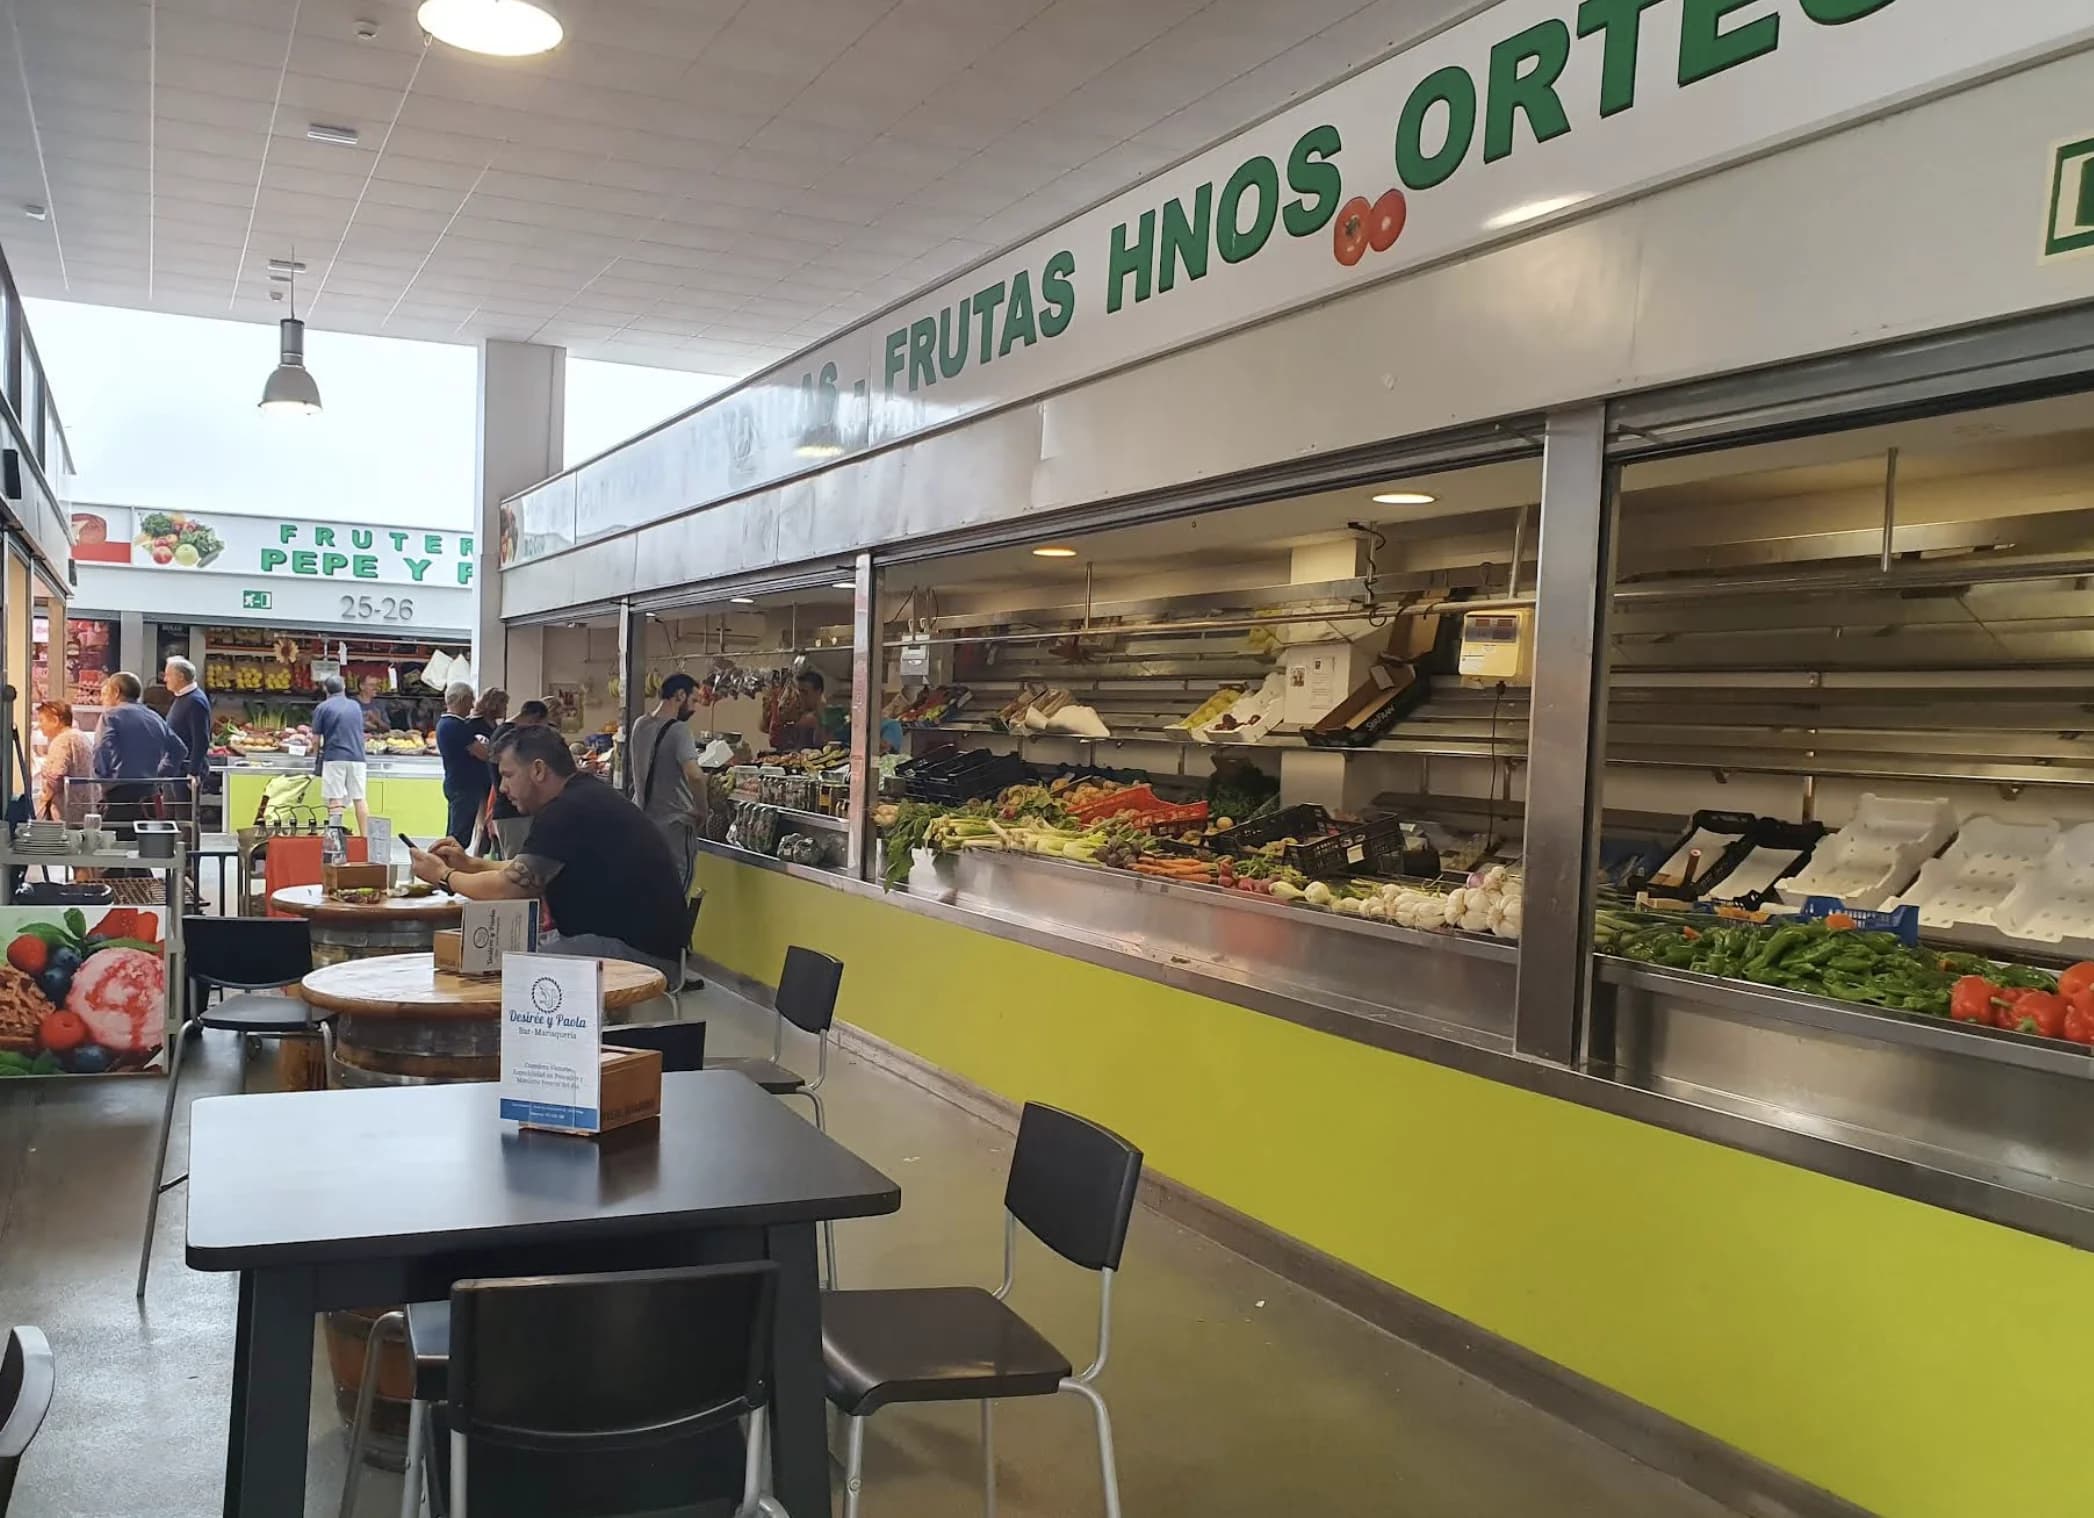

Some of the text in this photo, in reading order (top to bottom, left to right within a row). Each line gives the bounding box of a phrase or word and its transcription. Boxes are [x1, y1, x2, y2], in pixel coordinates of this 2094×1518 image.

[884, 250, 1076, 408] FRUTAS
[1107, 124, 1343, 315] HNOS
[1395, 0, 1897, 191] ORTE
[280, 524, 473, 557] FRUTER
[261, 548, 379, 579] PEPE
[403, 557, 432, 581] Y
[340, 594, 414, 621] 25-26
[547, 1015, 554, 1029] y
[556, 1014, 587, 1029] Paola
